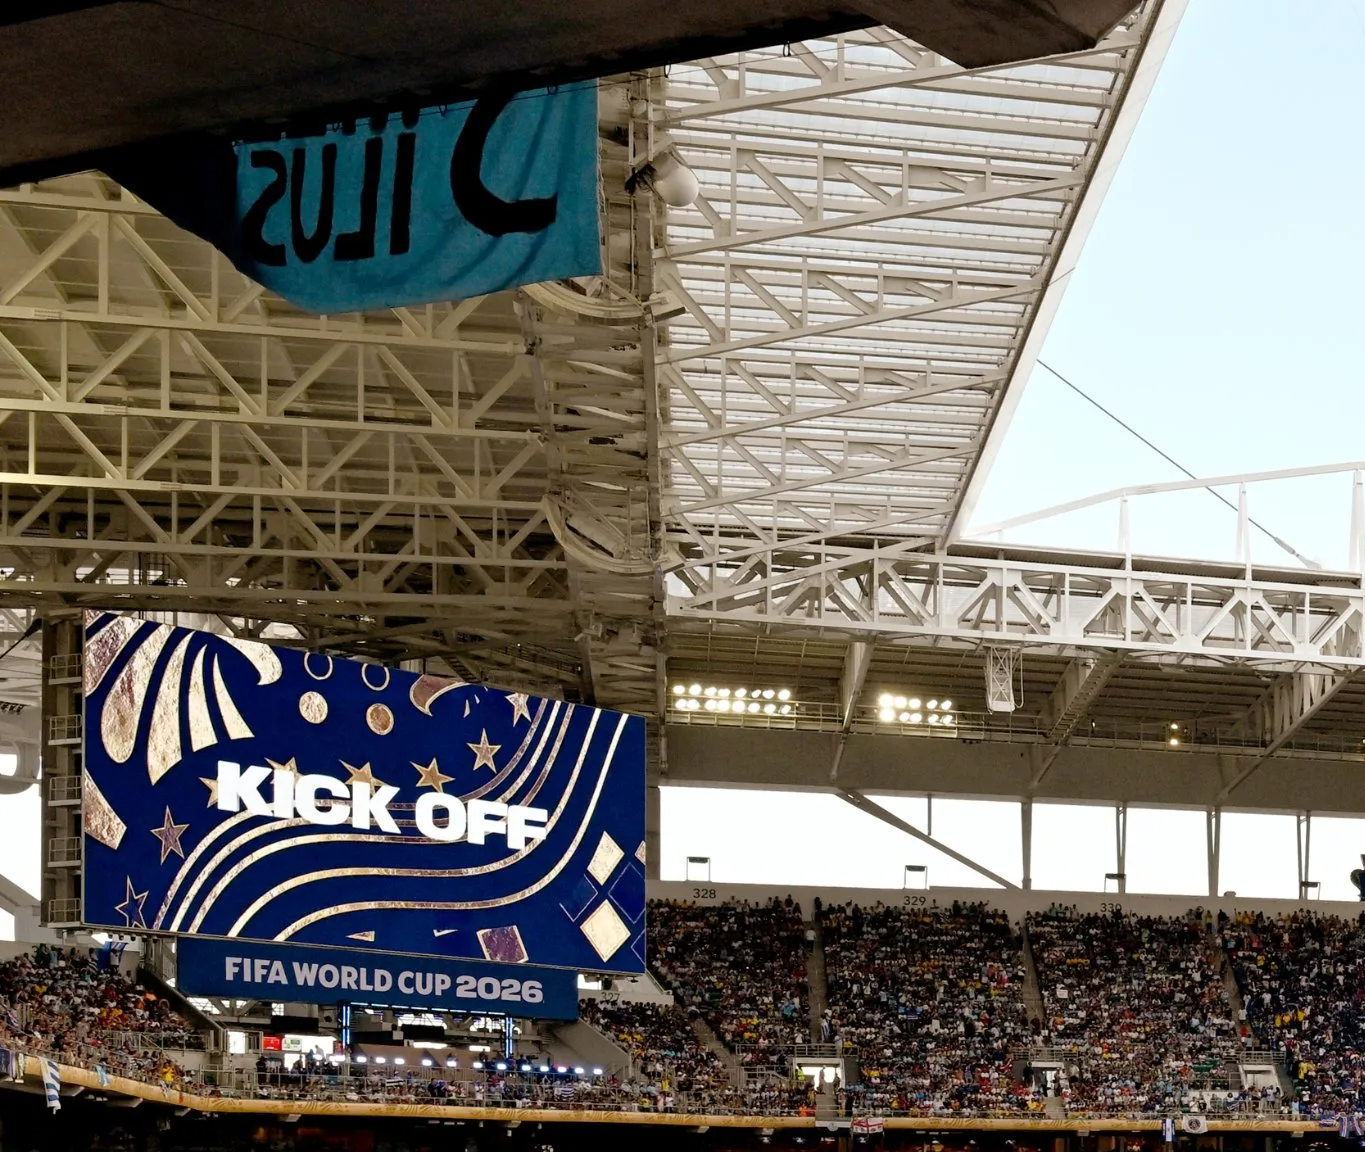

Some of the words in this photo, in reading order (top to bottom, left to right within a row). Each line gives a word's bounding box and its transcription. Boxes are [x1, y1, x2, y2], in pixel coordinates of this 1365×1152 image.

[217, 760, 401, 834] KICK
[415, 791, 548, 850] OFF
[693, 888, 716, 899] 328
[904, 895, 926, 906] 329
[225, 956, 289, 985] FIFA
[293, 959, 393, 993] WORLD
[398, 971, 451, 996] CUP
[456, 974, 544, 1001] 2026
[601, 991, 620, 1001] 327
